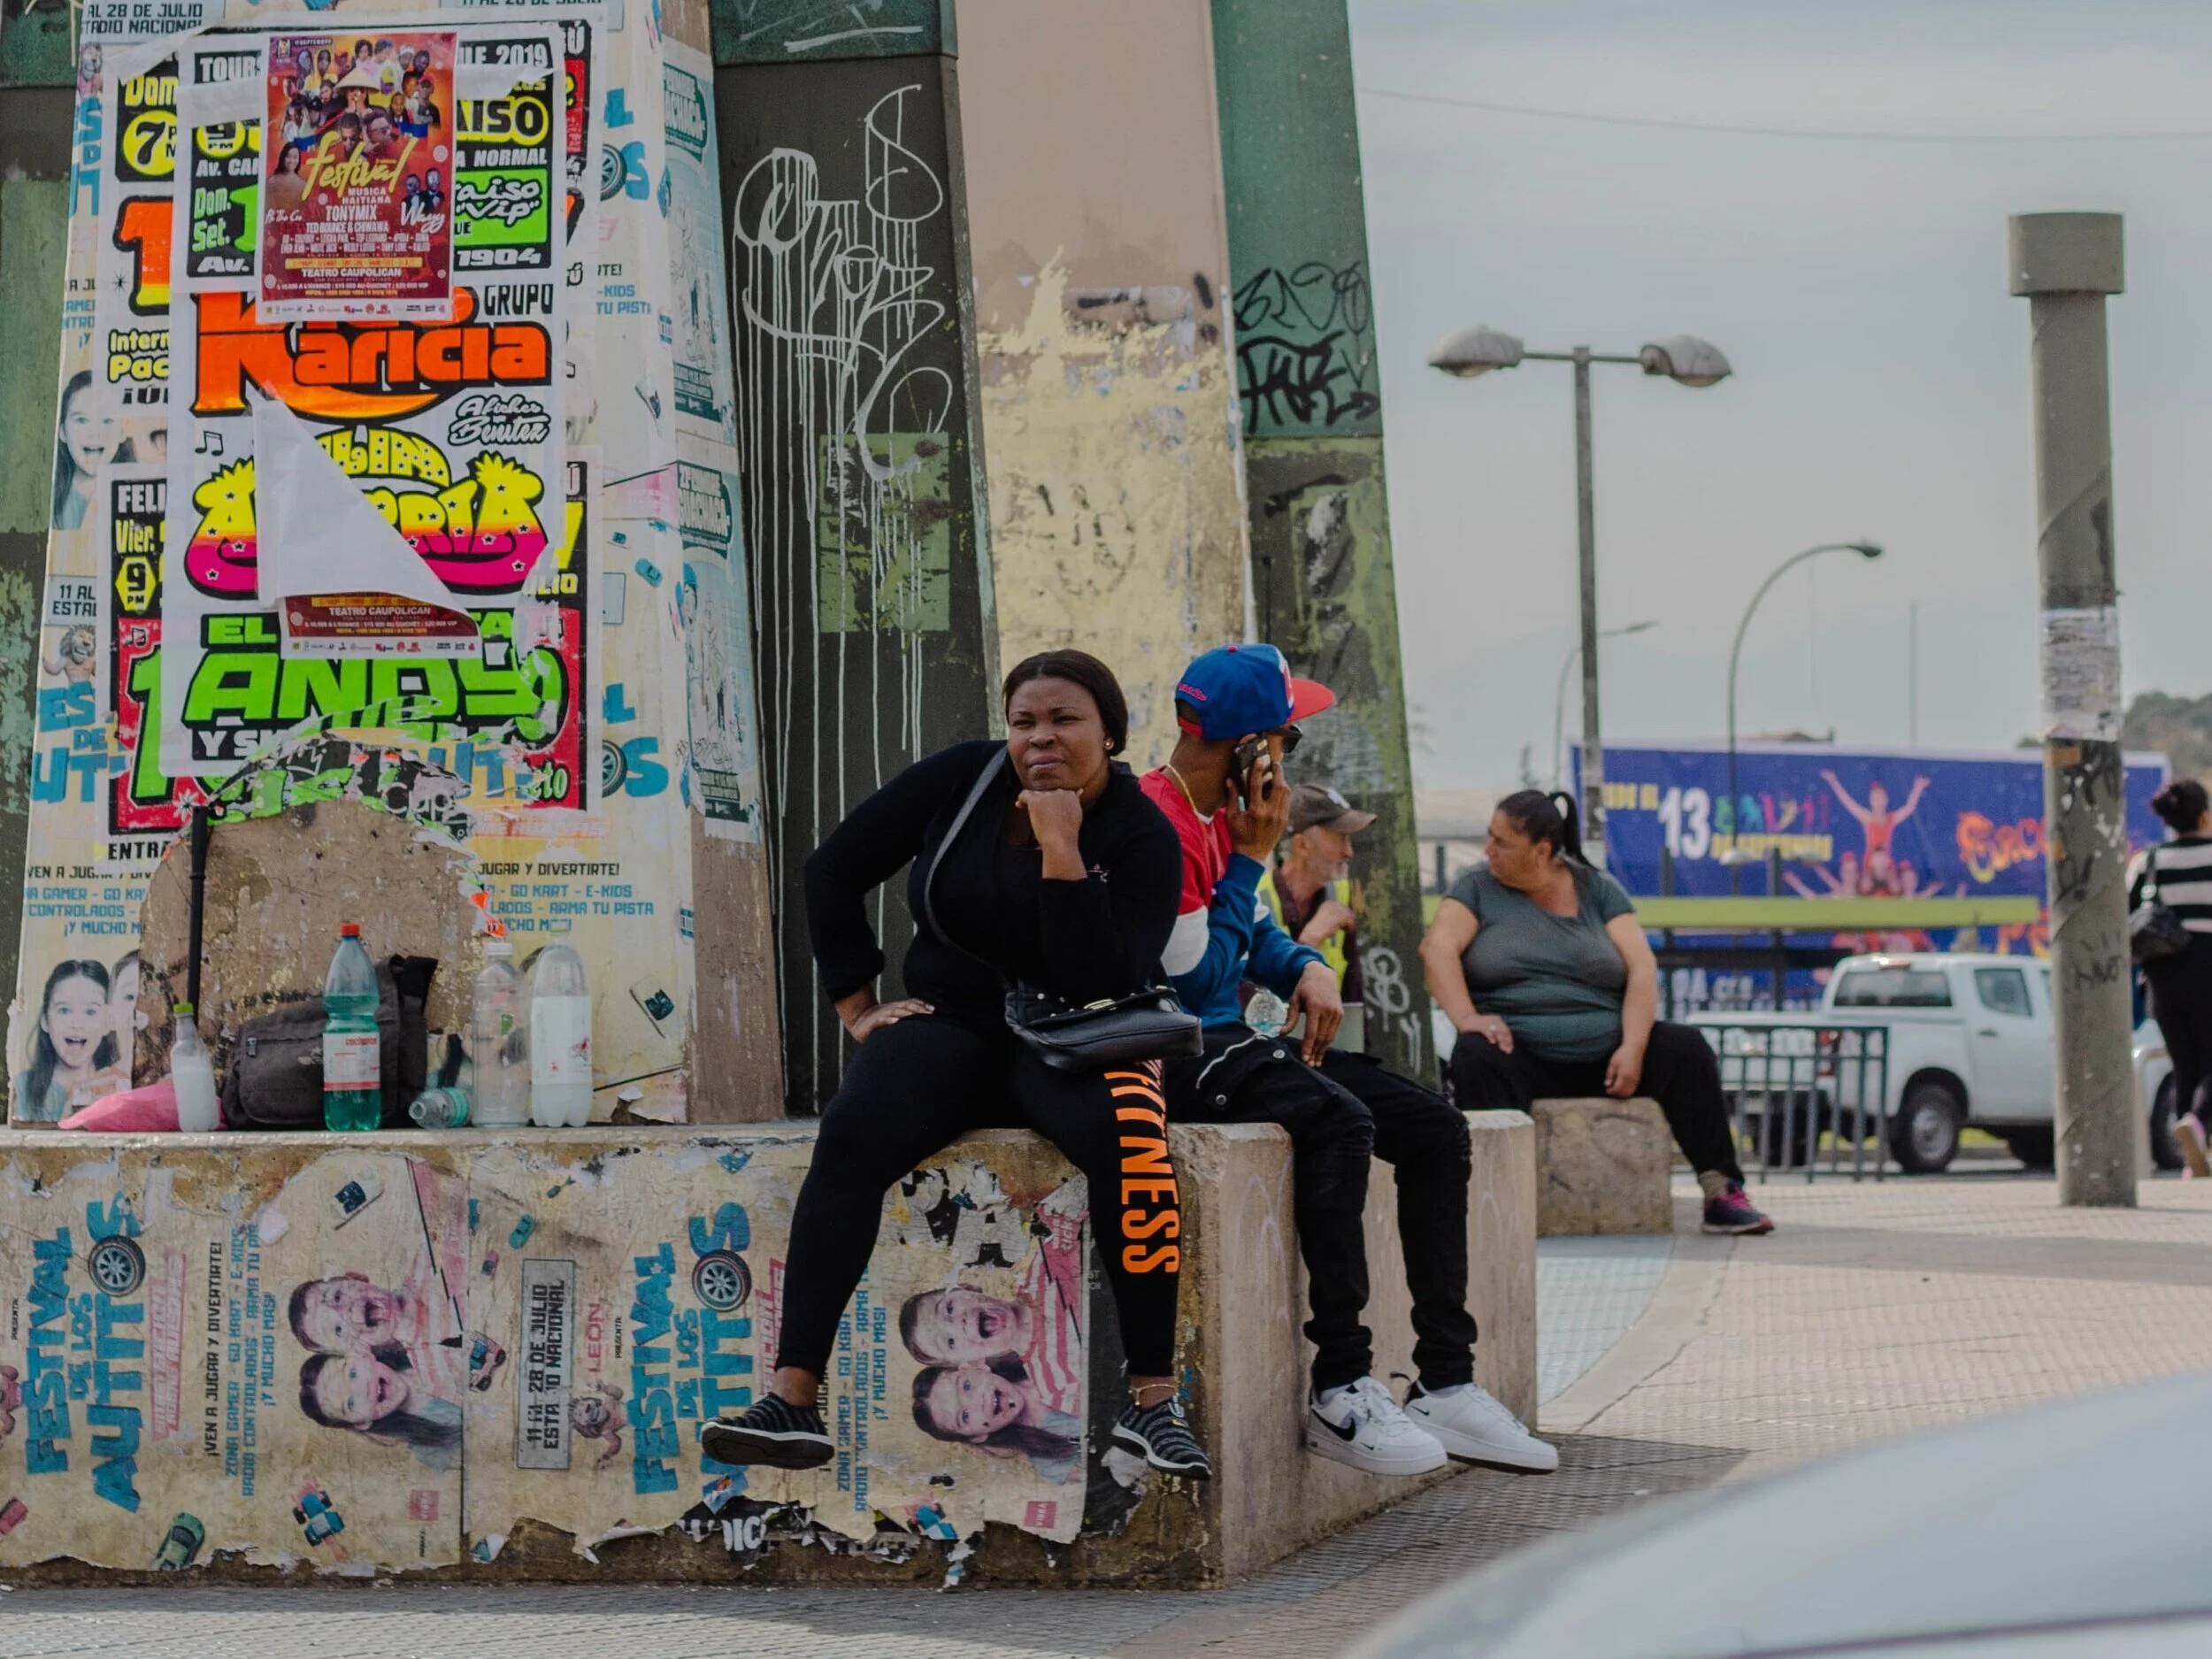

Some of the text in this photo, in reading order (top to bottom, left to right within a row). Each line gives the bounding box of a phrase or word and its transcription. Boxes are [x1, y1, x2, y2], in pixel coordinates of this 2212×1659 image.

[107, 4, 128, 18] 28
[134, 4, 152, 18] DE
[157, 4, 204, 18] JULIO
[496, 43, 549, 68] 2019
[136, 120, 166, 166] 7
[474, 147, 548, 167] NORMAL
[196, 159, 222, 178] Av.
[302, 130, 419, 201] Festival
[194, 188, 232, 219] Dom.
[326, 205, 378, 221] TONYMIX
[196, 257, 250, 273] Av.
[302, 267, 403, 278] TEATRO CAUPOLICAN
[457, 248, 541, 267] 1904
[484, 283, 555, 316] GRUPO
[114, 518, 156, 554] Vier.
[59, 584, 73, 599] 11
[126, 562, 147, 593] 9
[127, 594, 145, 604] PM
[328, 606, 431, 616] TEATRO CAUPOLICAN
[209, 617, 278, 646] EL
[197, 730, 227, 758] Y
[1658, 786, 1711, 859] 13
[478, 863, 620, 876] JUGAR Y DIVERTIRTE!
[42, 887, 88, 901] GAMER
[104, 887, 121, 901] GO
[510, 884, 633, 898] GO KART E-KIDS
[28, 903, 126, 918] CONTROLADOS
[549, 901, 588, 915] ARMA
[592, 901, 611, 915] TU
[614, 901, 655, 916] PISTA
[81, 921, 127, 935] MUCHO
[1104, 1069, 1181, 1273] FITNESS
[247, 1252, 261, 1272] TU
[245, 1277, 260, 1319] ARMA
[530, 1284, 549, 1335] JULIO
[856, 1289, 869, 1332] ARMA
[228, 1298, 242, 1338] KART
[544, 1279, 566, 1369] NACIONAL
[21, 1226, 73, 1475] FESTIVAL
[204, 1241, 223, 1456] ¡VEN A JUGAR Y DIVERTIRTE!
[227, 1342, 241, 1363] GO
[261, 1334, 276, 1386] MUCHO
[529, 1340, 545, 1364] DE
[673, 1308, 699, 1420] DE LOS
[872, 1307, 889, 1420] ¡Y MUCHO MAS!
[67, 1361, 92, 1402] DE
[528, 1370, 544, 1393] 28
[626, 1241, 679, 1495] FESTIVAL
[837, 1356, 851, 1377] GO
[227, 1380, 241, 1432] GAMER
[242, 1337, 258, 1448] CONTROLADOS
[226, 1434, 239, 1478] ZONA
[837, 1450, 850, 1492] ZONA
[242, 1452, 256, 1497] RADIO
[854, 1465, 868, 1512] RADIO
